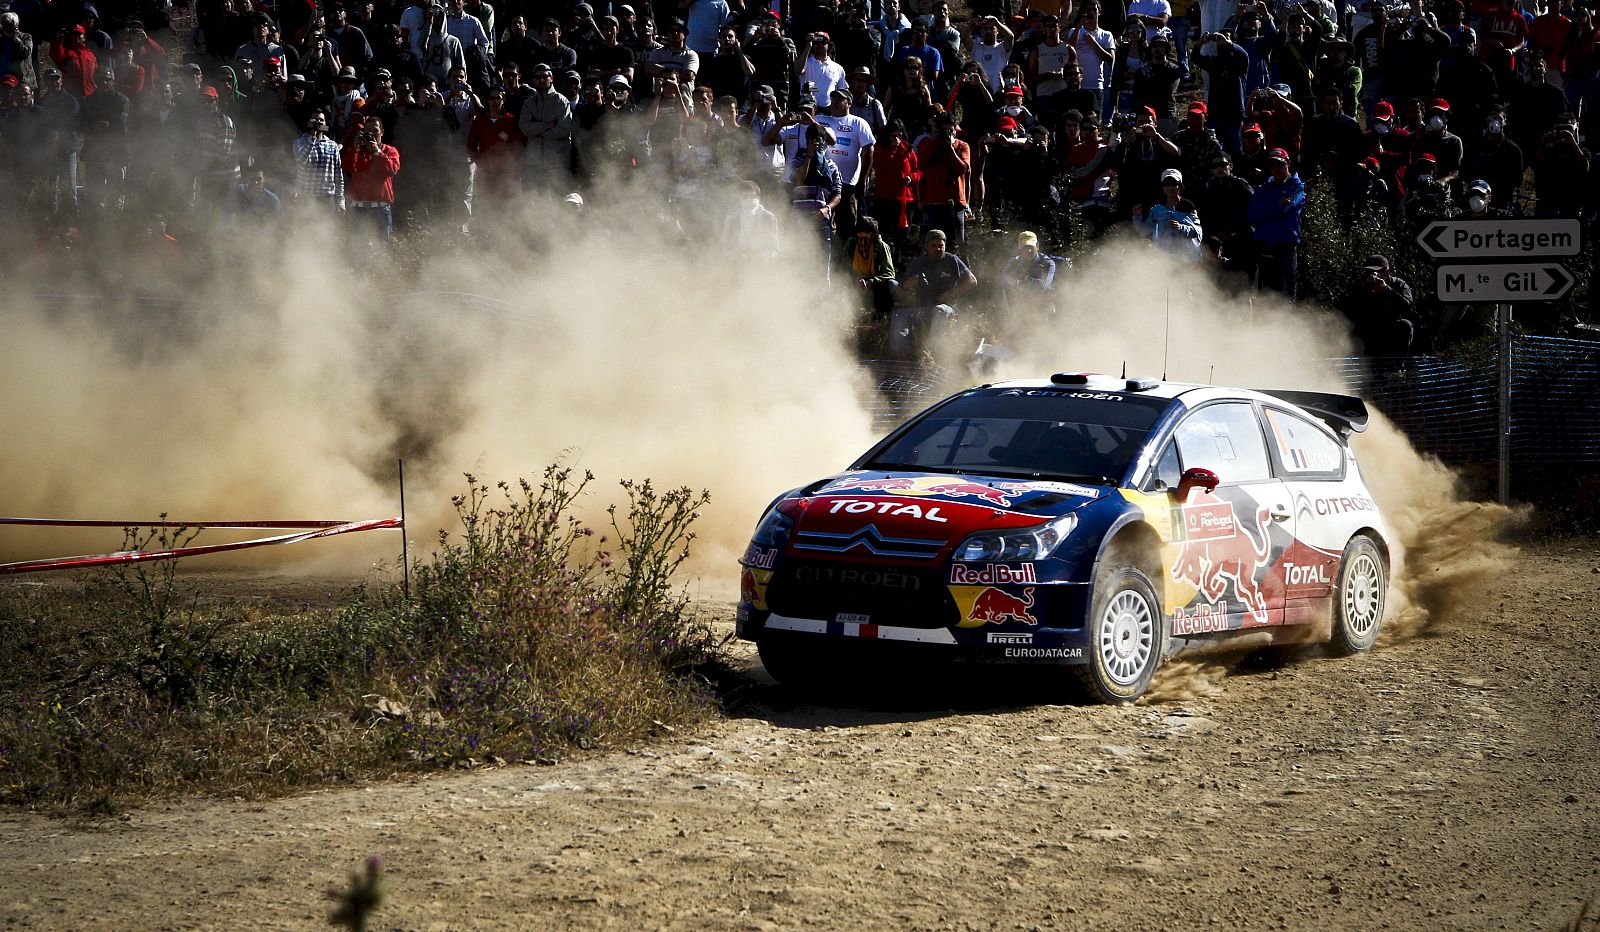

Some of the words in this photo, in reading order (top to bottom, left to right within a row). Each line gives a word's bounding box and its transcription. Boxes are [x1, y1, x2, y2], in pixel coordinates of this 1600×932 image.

[1454, 229, 1572, 251] Portagem
[1503, 272, 1538, 292] Gil
[829, 499, 948, 522] TOTAL
[1200, 515, 1233, 527] Portugal
[748, 546, 778, 569] Bull
[951, 564, 994, 584] Red
[995, 563, 1036, 583] Bull
[1283, 562, 1330, 585] TOTAL
[1173, 603, 1201, 635] Red
[1201, 601, 1228, 633] Bull
[987, 632, 1033, 644] PIRELLI
[1005, 648, 1082, 658] EURODATACAR
